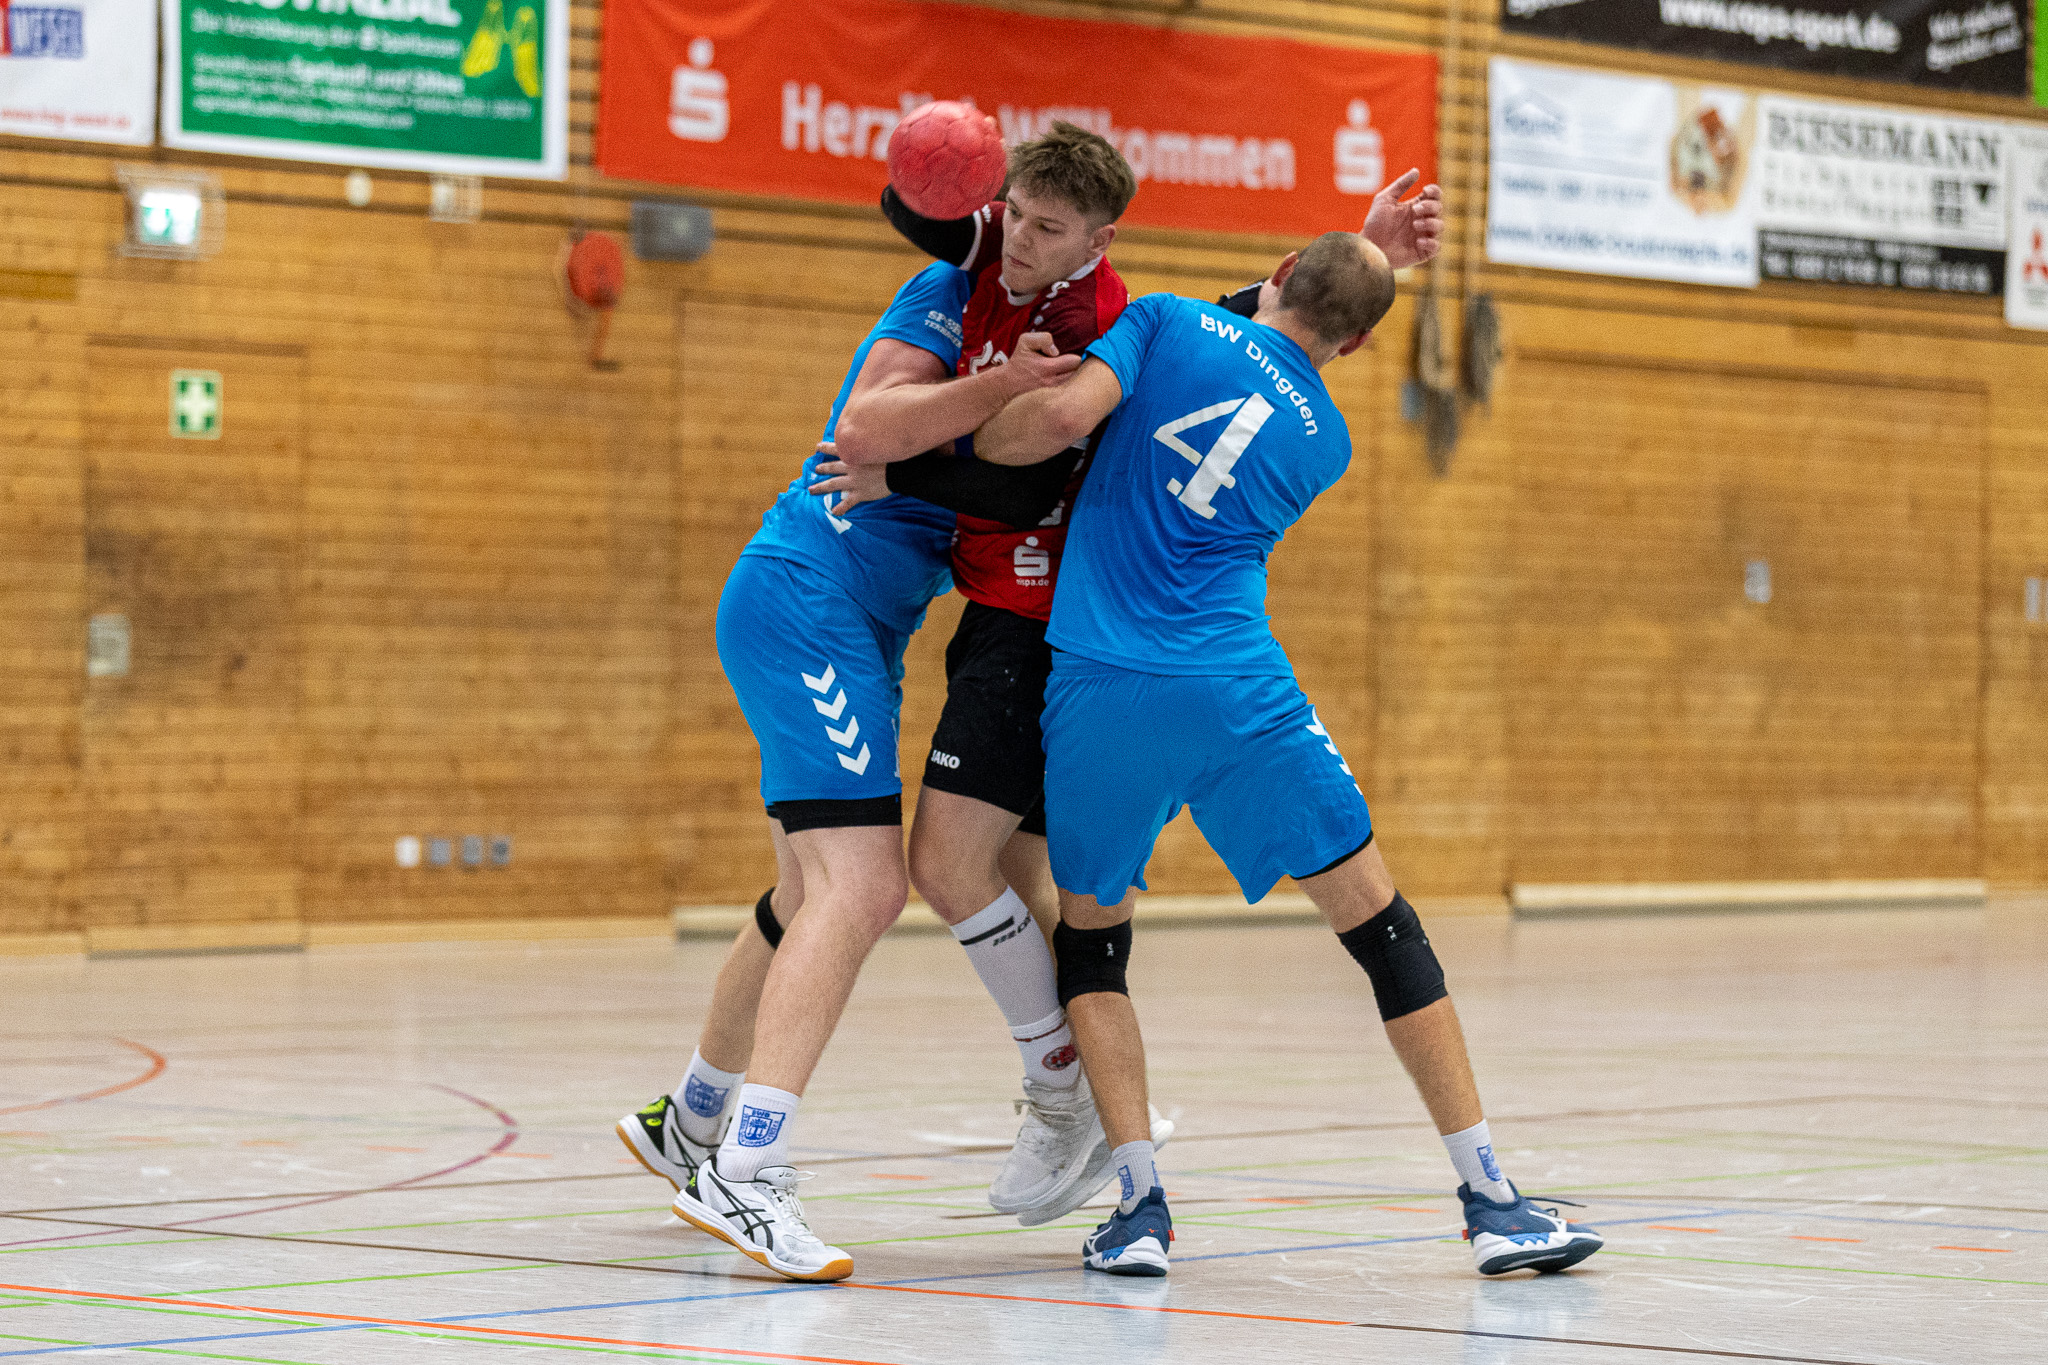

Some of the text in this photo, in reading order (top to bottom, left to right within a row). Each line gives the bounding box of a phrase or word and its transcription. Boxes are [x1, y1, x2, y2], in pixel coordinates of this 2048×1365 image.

[781, 82, 1296, 191] Herz Wkommen
[1200, 313, 1319, 436] BW Dingden
[1152, 392, 1275, 520] 4
[930, 749, 961, 769] JAKO
